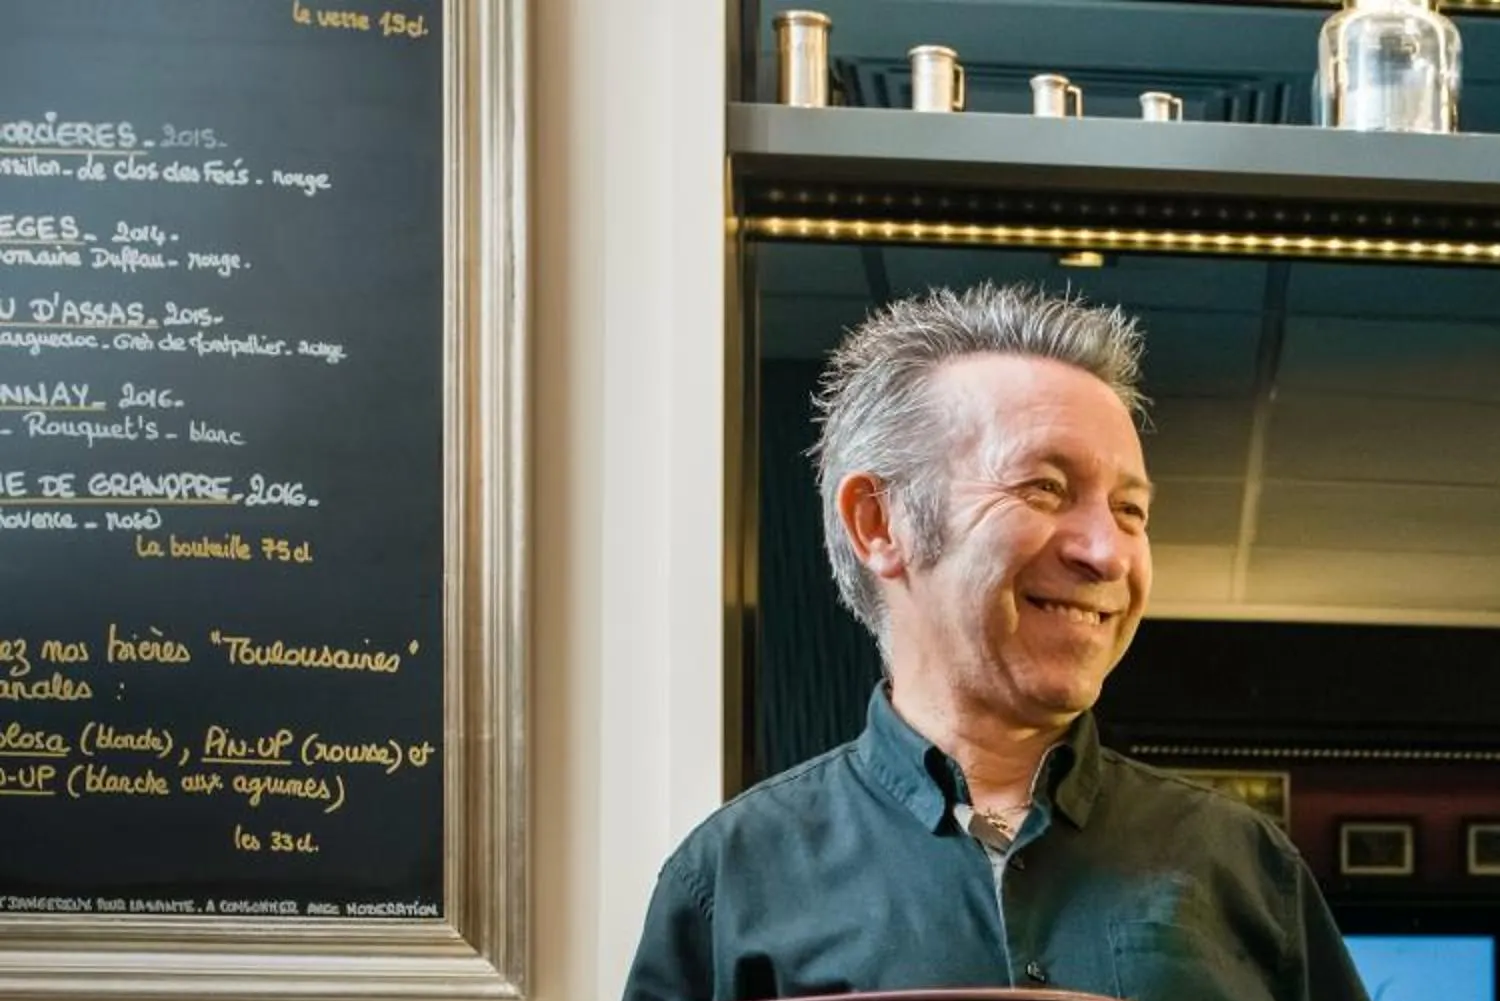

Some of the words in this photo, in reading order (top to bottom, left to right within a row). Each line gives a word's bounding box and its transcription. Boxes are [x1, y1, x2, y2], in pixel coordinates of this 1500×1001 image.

[0, 245, 82, 266] omaine
[189, 419, 247, 446] blanc
[37, 472, 76, 498] DE
[41, 640, 90, 663] nos
[107, 623, 192, 664] bières
[407, 740, 435, 767] et
[234, 823, 261, 850] les
